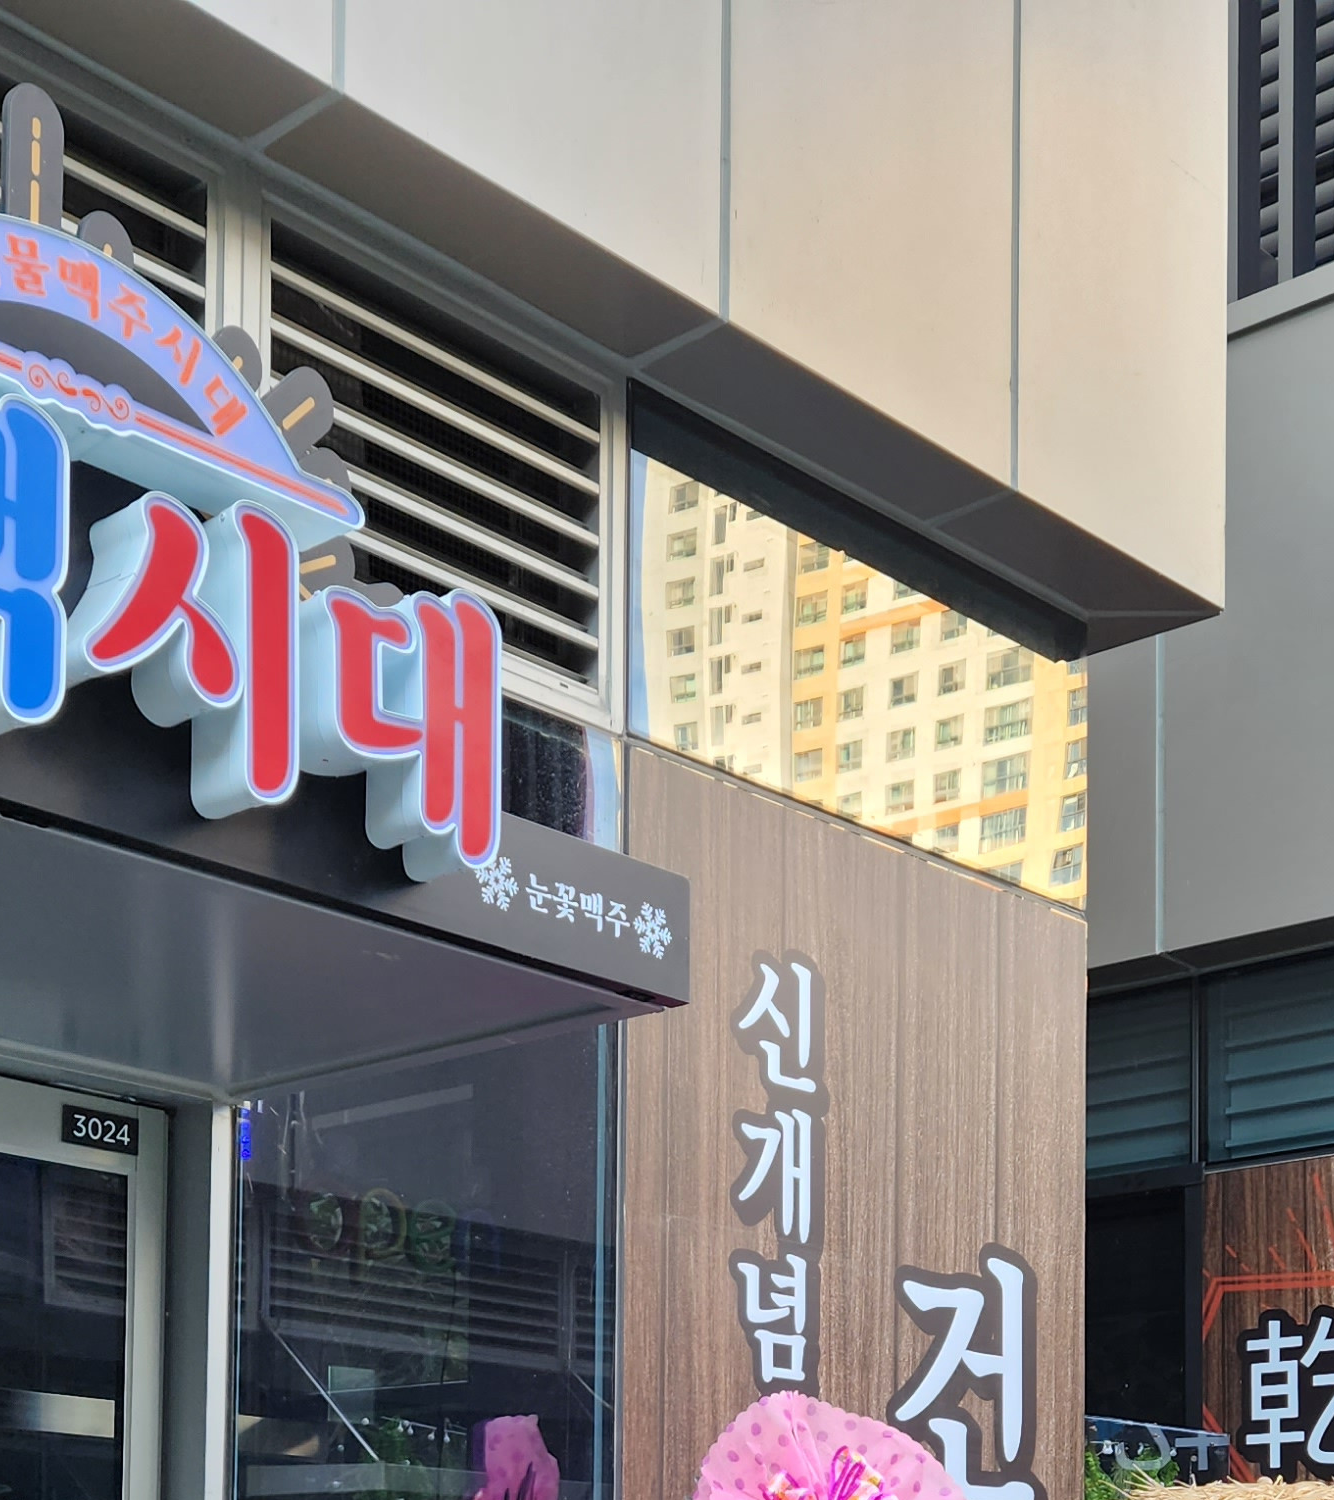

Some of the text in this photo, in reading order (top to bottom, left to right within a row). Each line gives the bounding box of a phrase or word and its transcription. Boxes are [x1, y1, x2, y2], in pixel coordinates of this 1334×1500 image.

[525, 872, 631, 939] 눈꽃맥주
[72, 1113, 131, 1147] 3024
[738, 960, 817, 1384] 신개념
